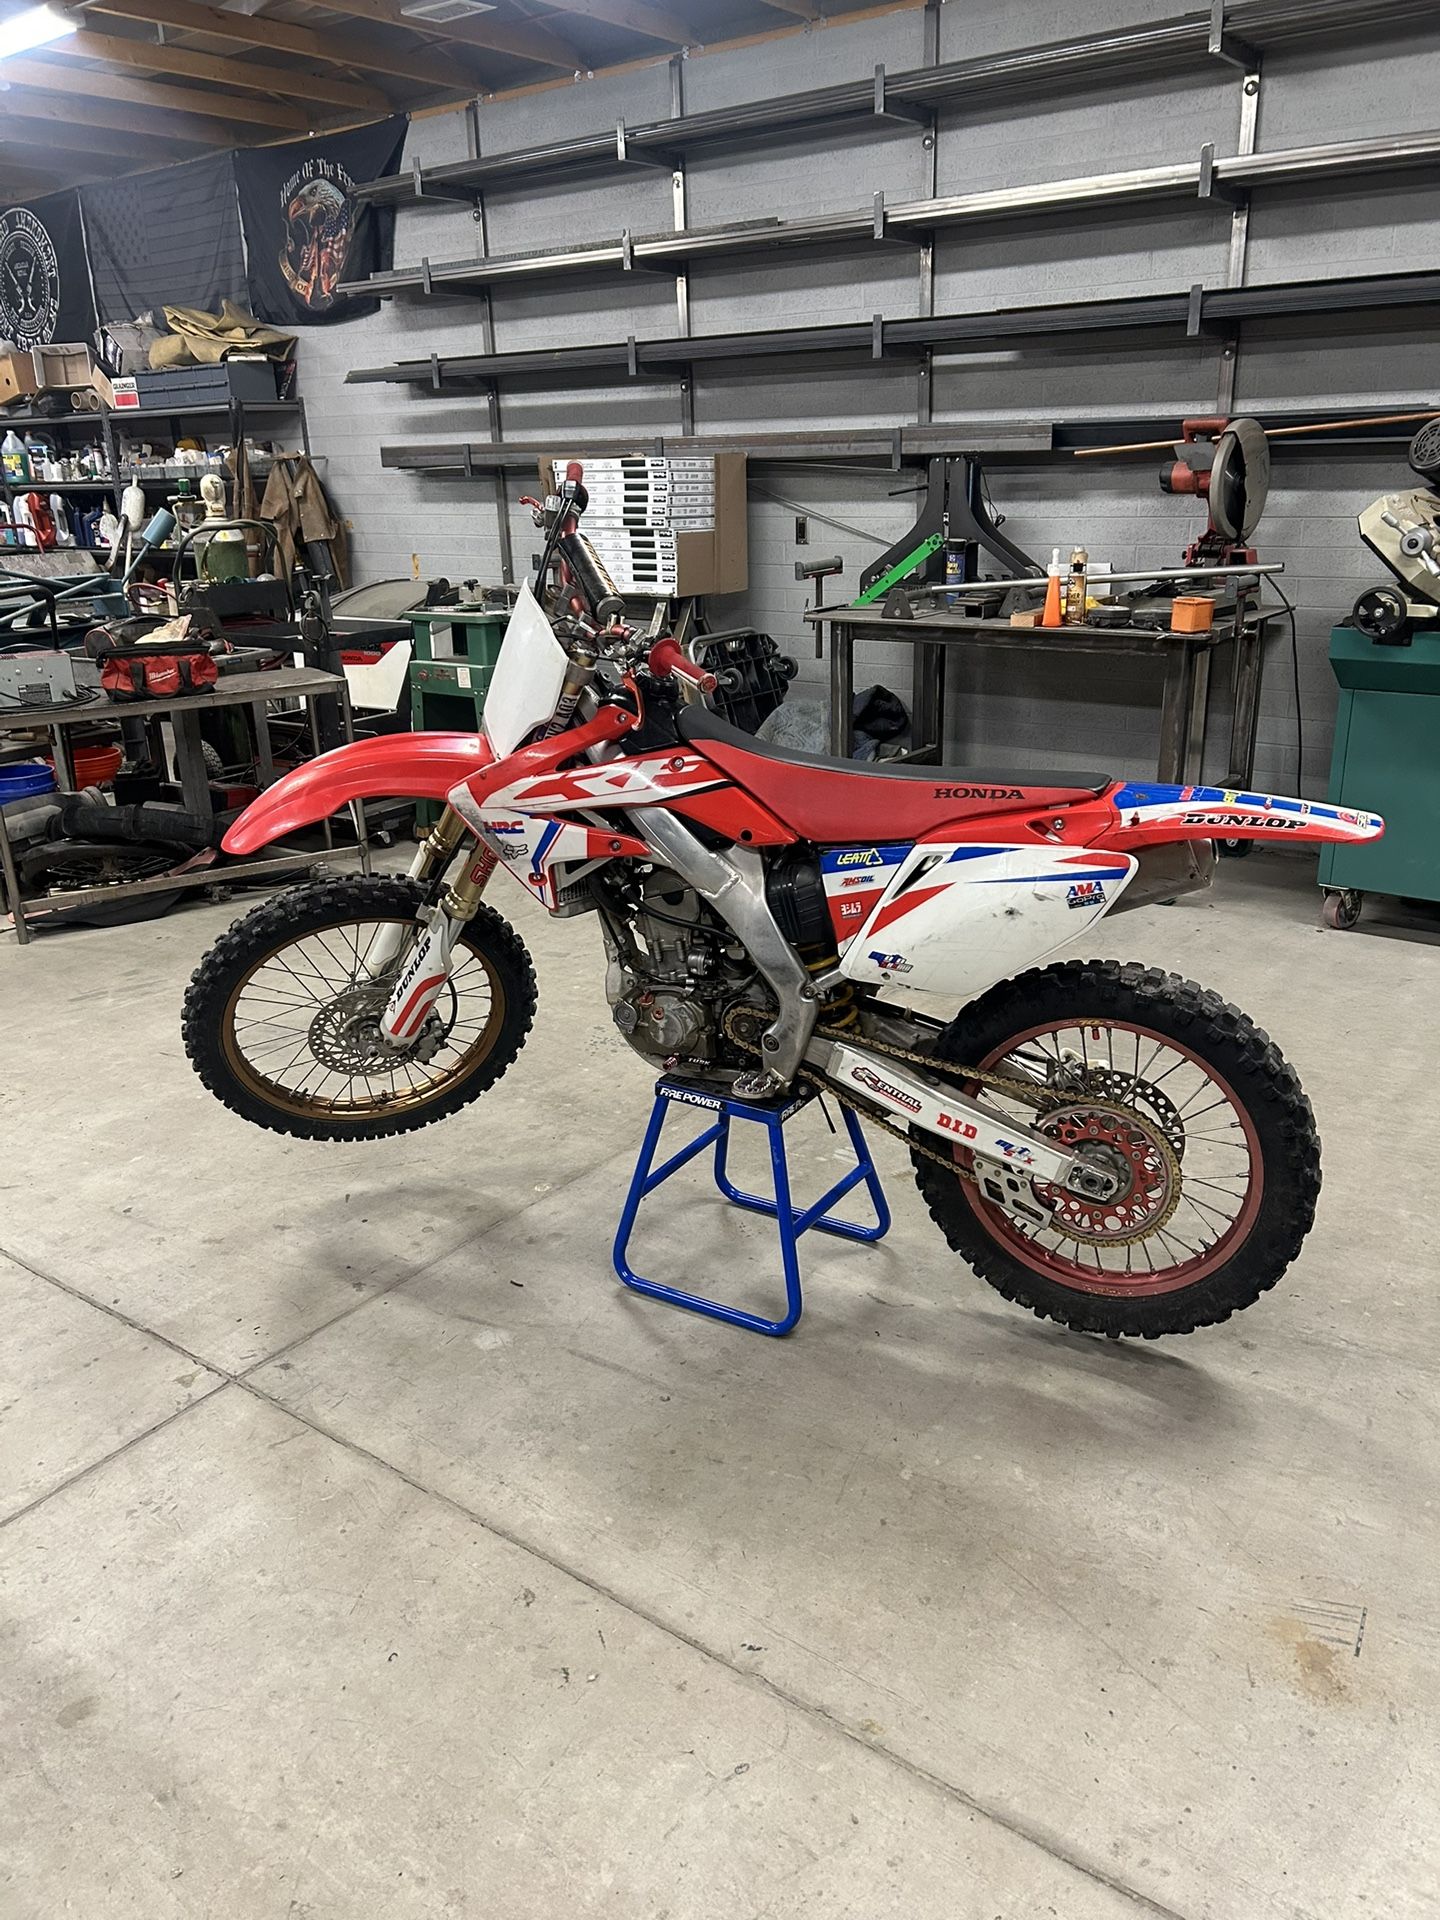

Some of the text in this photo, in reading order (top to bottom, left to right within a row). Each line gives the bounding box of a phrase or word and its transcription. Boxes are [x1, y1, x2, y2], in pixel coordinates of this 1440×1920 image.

[317, 158, 334, 179] The
[934, 788, 1025, 800] HONDA
[483, 821, 525, 834] HRC
[1182, 813, 1306, 830] DUNLOP
[840, 875, 875, 887] AMSOIL
[1065, 880, 1104, 898] AMA
[396, 936, 431, 1002] DUNLOP
[688, 1057, 711, 1066] TUSK
[851, 1066, 923, 1110] RENTHAL
[684, 1093, 722, 1110] POWER
[937, 1113, 978, 1139] D.I.D
